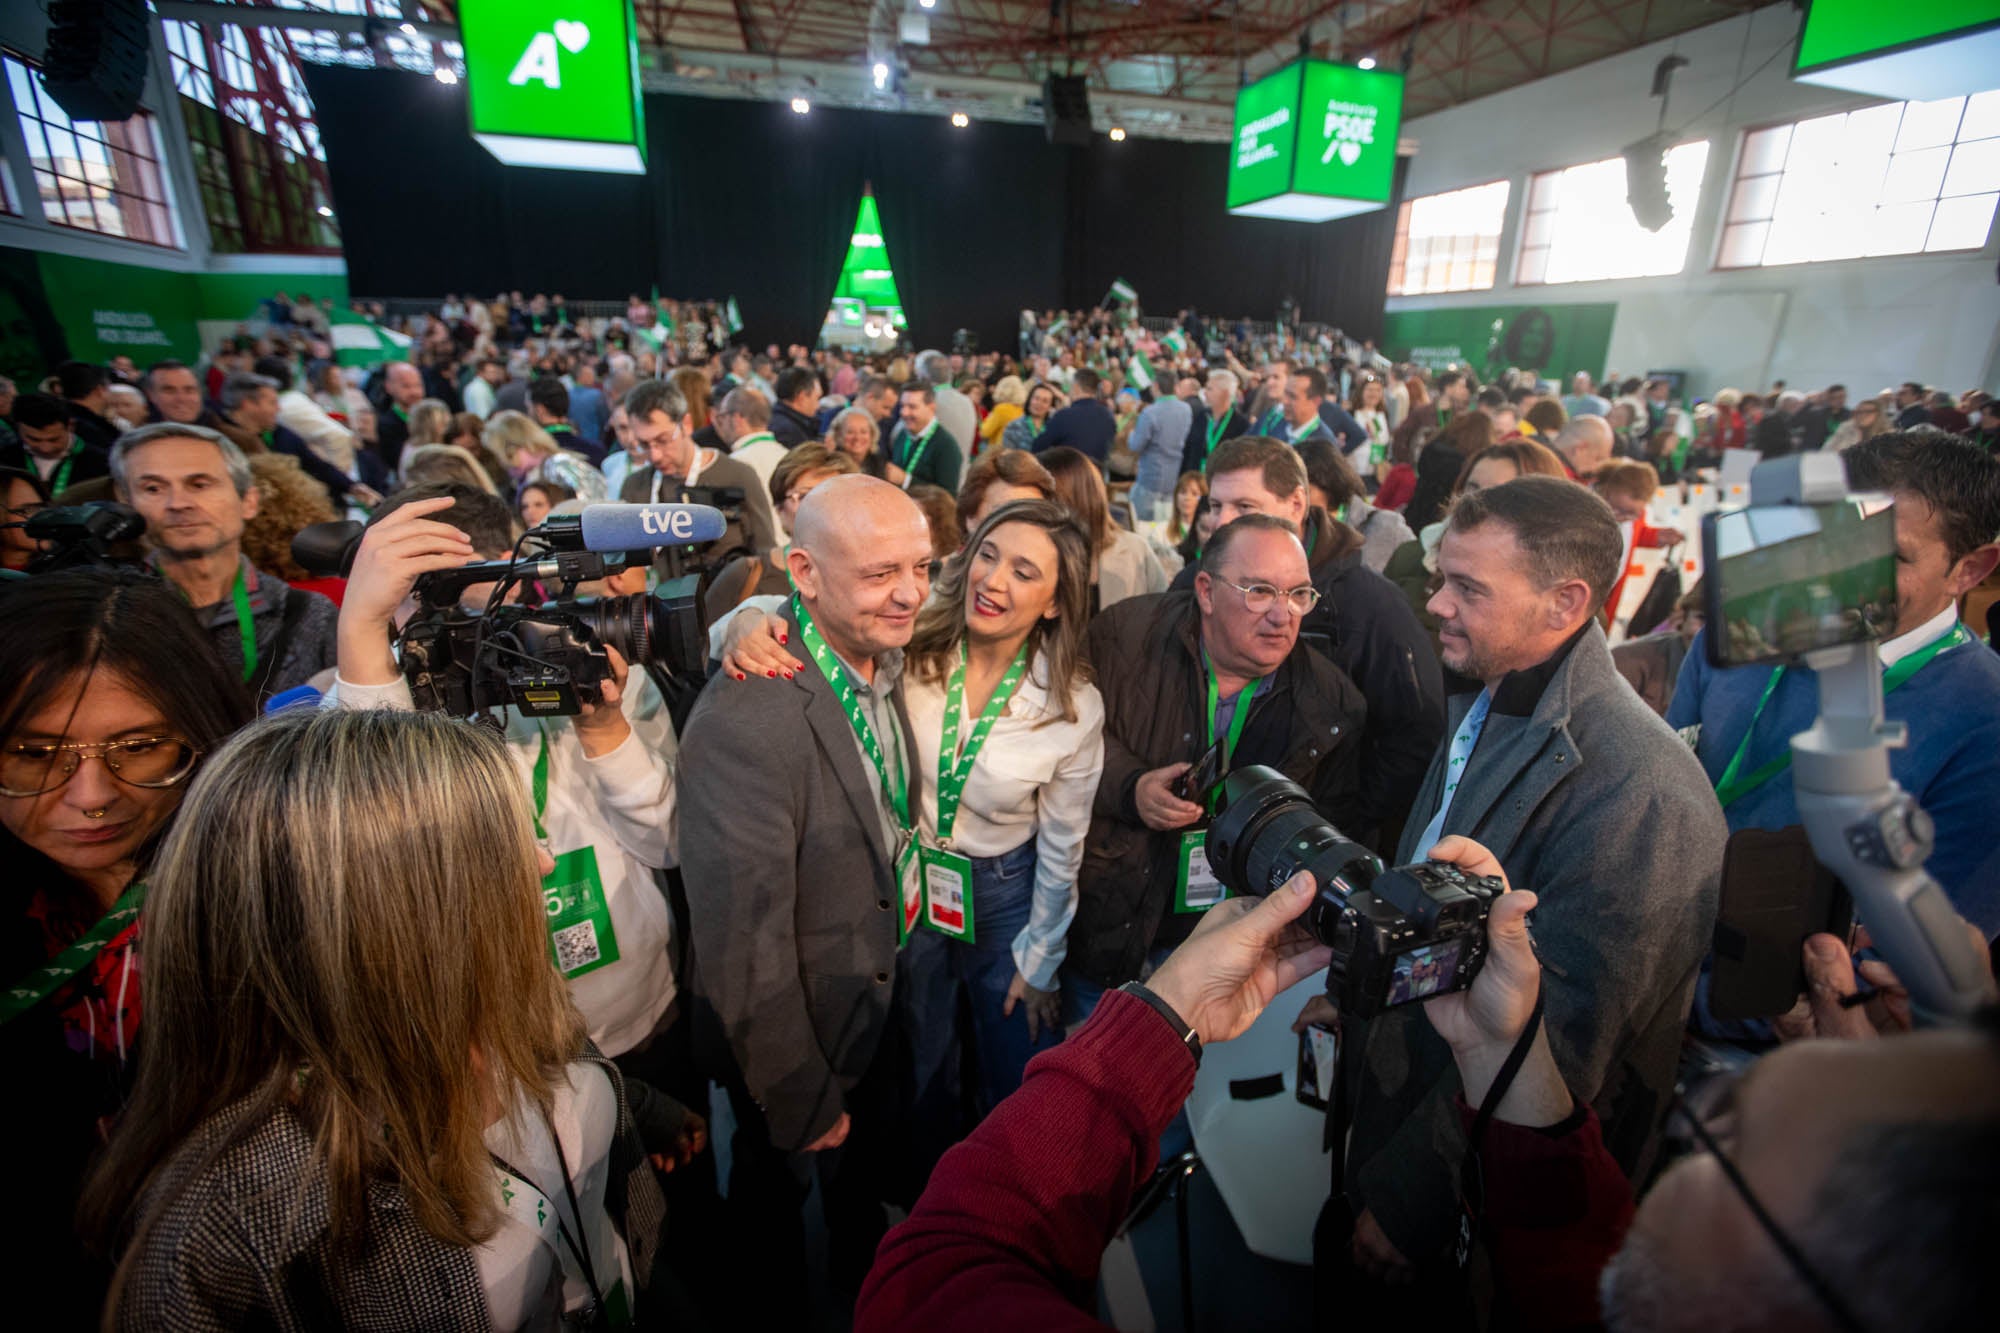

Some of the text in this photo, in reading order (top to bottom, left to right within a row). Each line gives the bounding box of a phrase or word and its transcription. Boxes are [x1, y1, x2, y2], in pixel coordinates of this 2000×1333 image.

[507, 31, 561, 89] A
[1323, 112, 1376, 144] PSOE
[639, 508, 693, 539] tve
